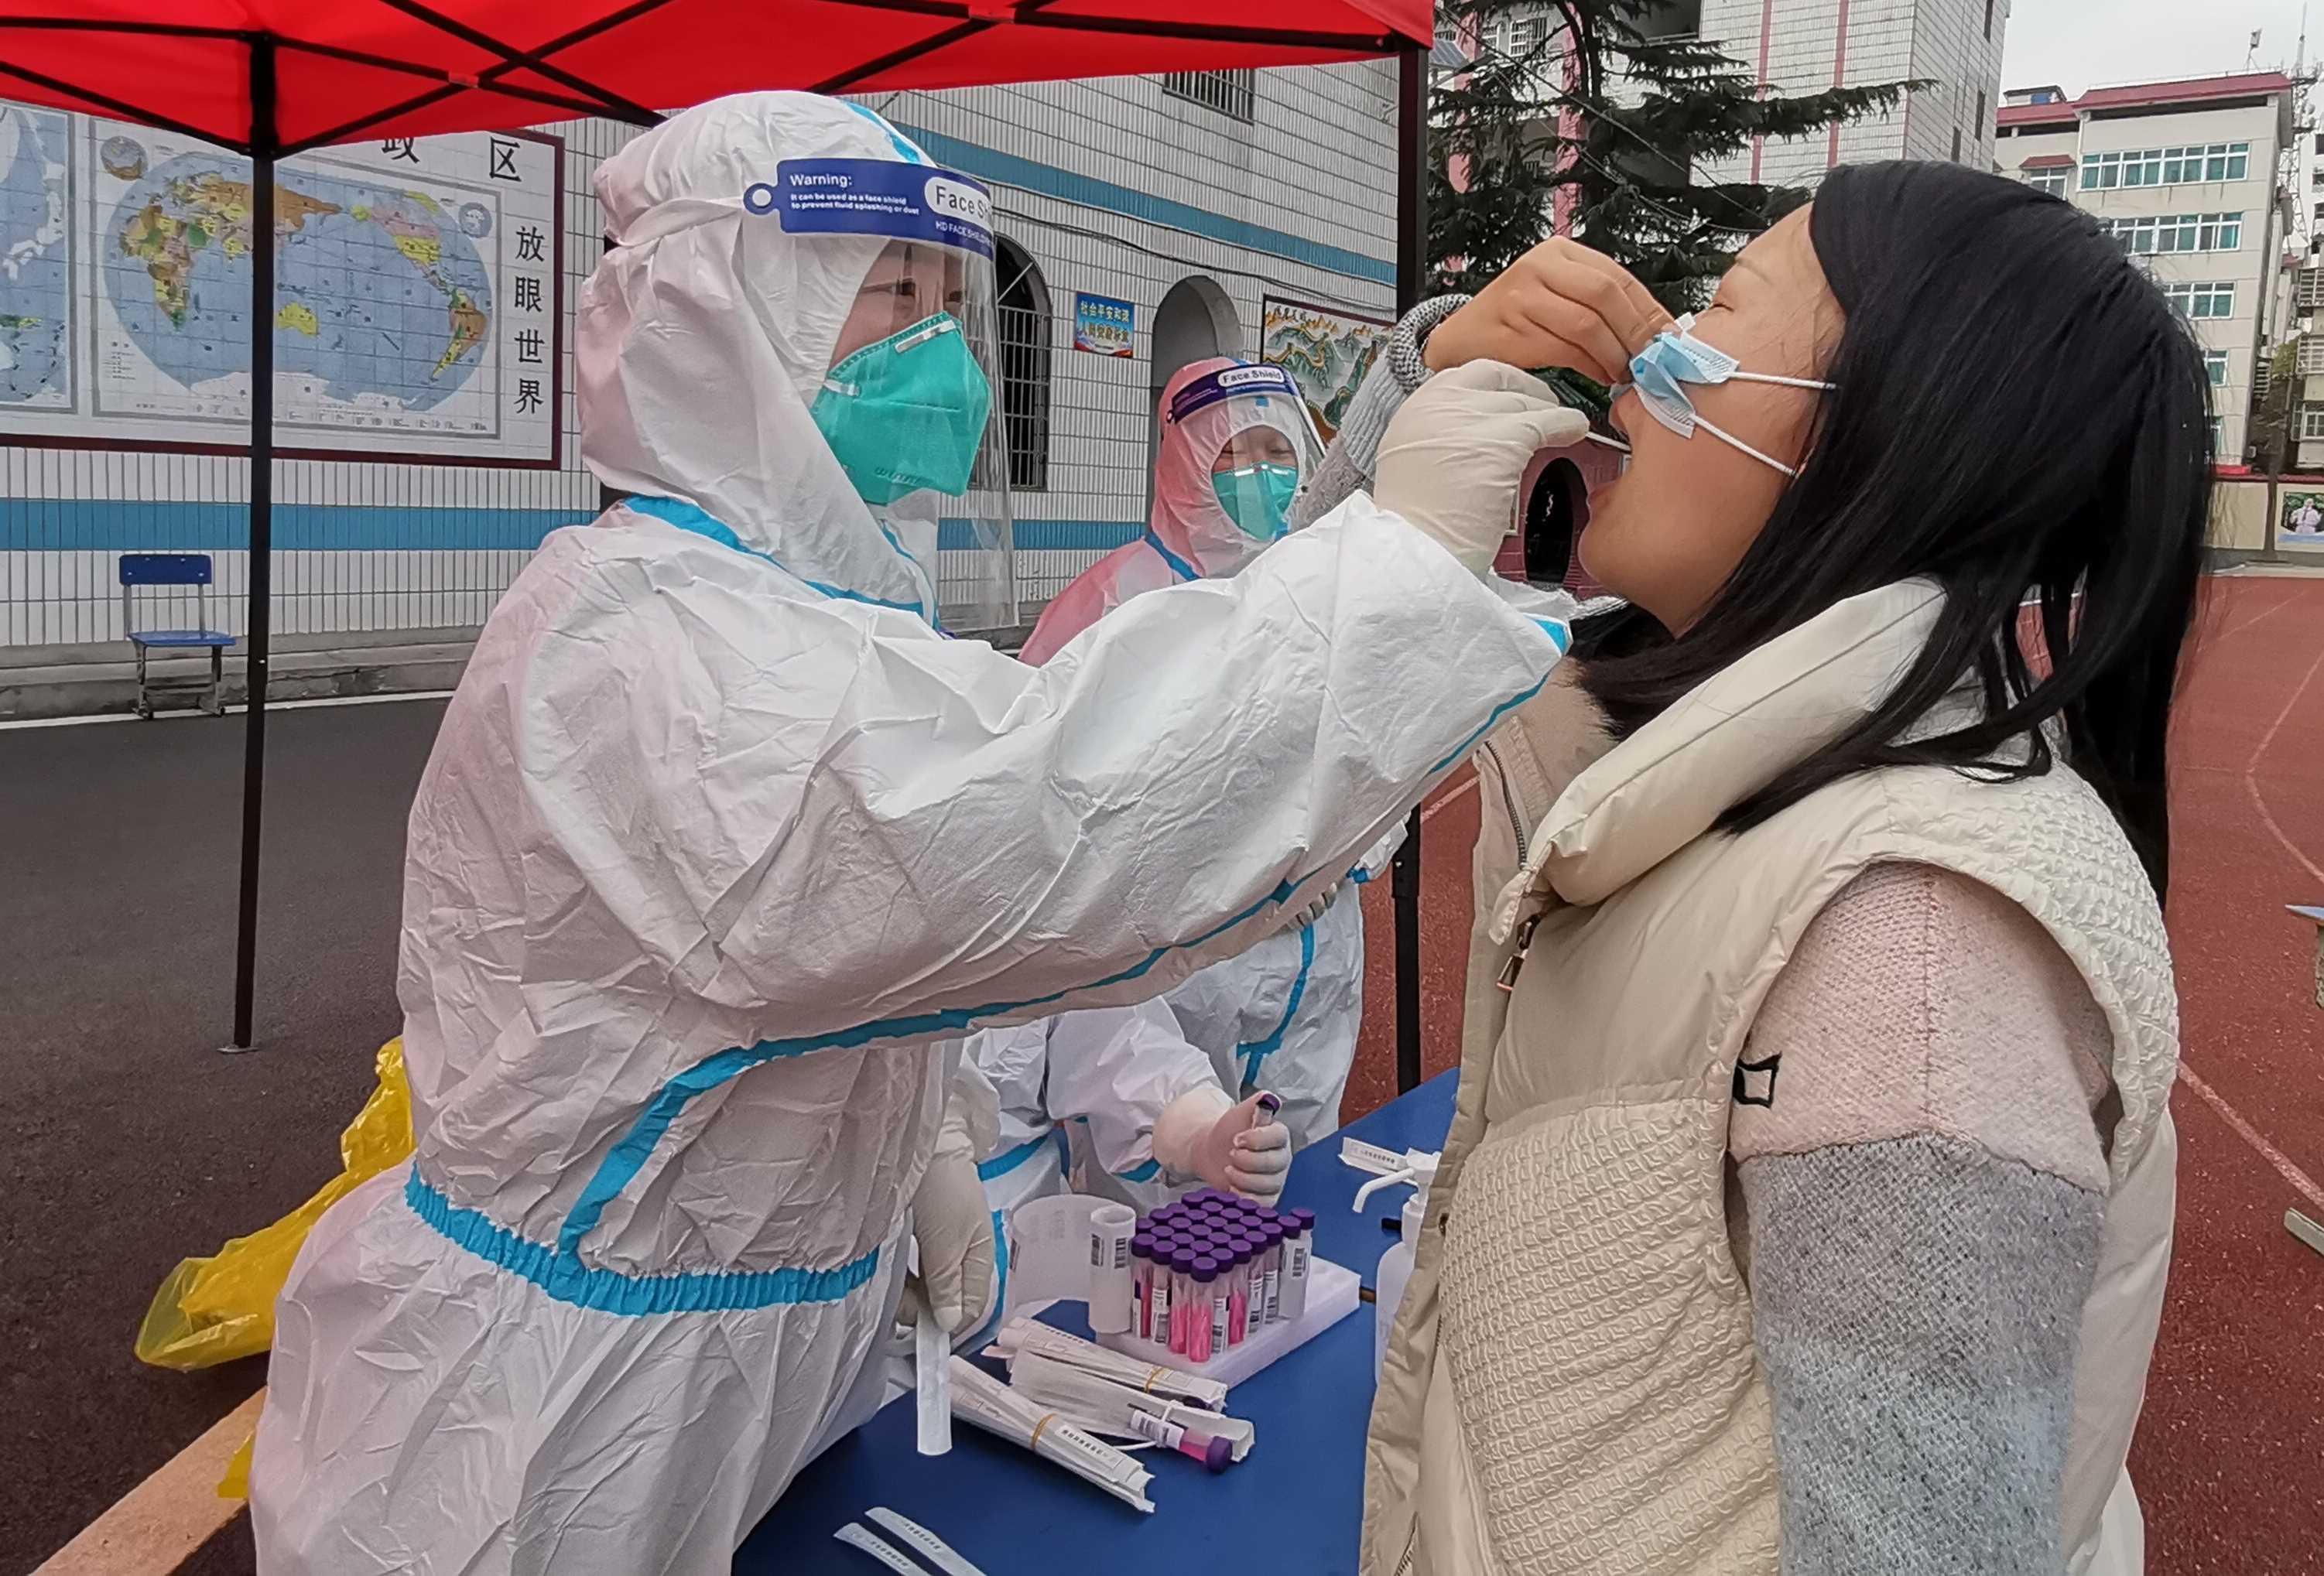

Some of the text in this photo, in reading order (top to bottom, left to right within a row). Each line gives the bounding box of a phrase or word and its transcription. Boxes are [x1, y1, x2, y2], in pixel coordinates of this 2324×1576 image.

[790, 173, 852, 188] Warning:
[865, 194, 882, 203] face
[936, 185, 975, 215] Face
[935, 221, 948, 231] HD
[515, 226, 546, 414] 放眼世界
[1223, 372, 1250, 384] Face
